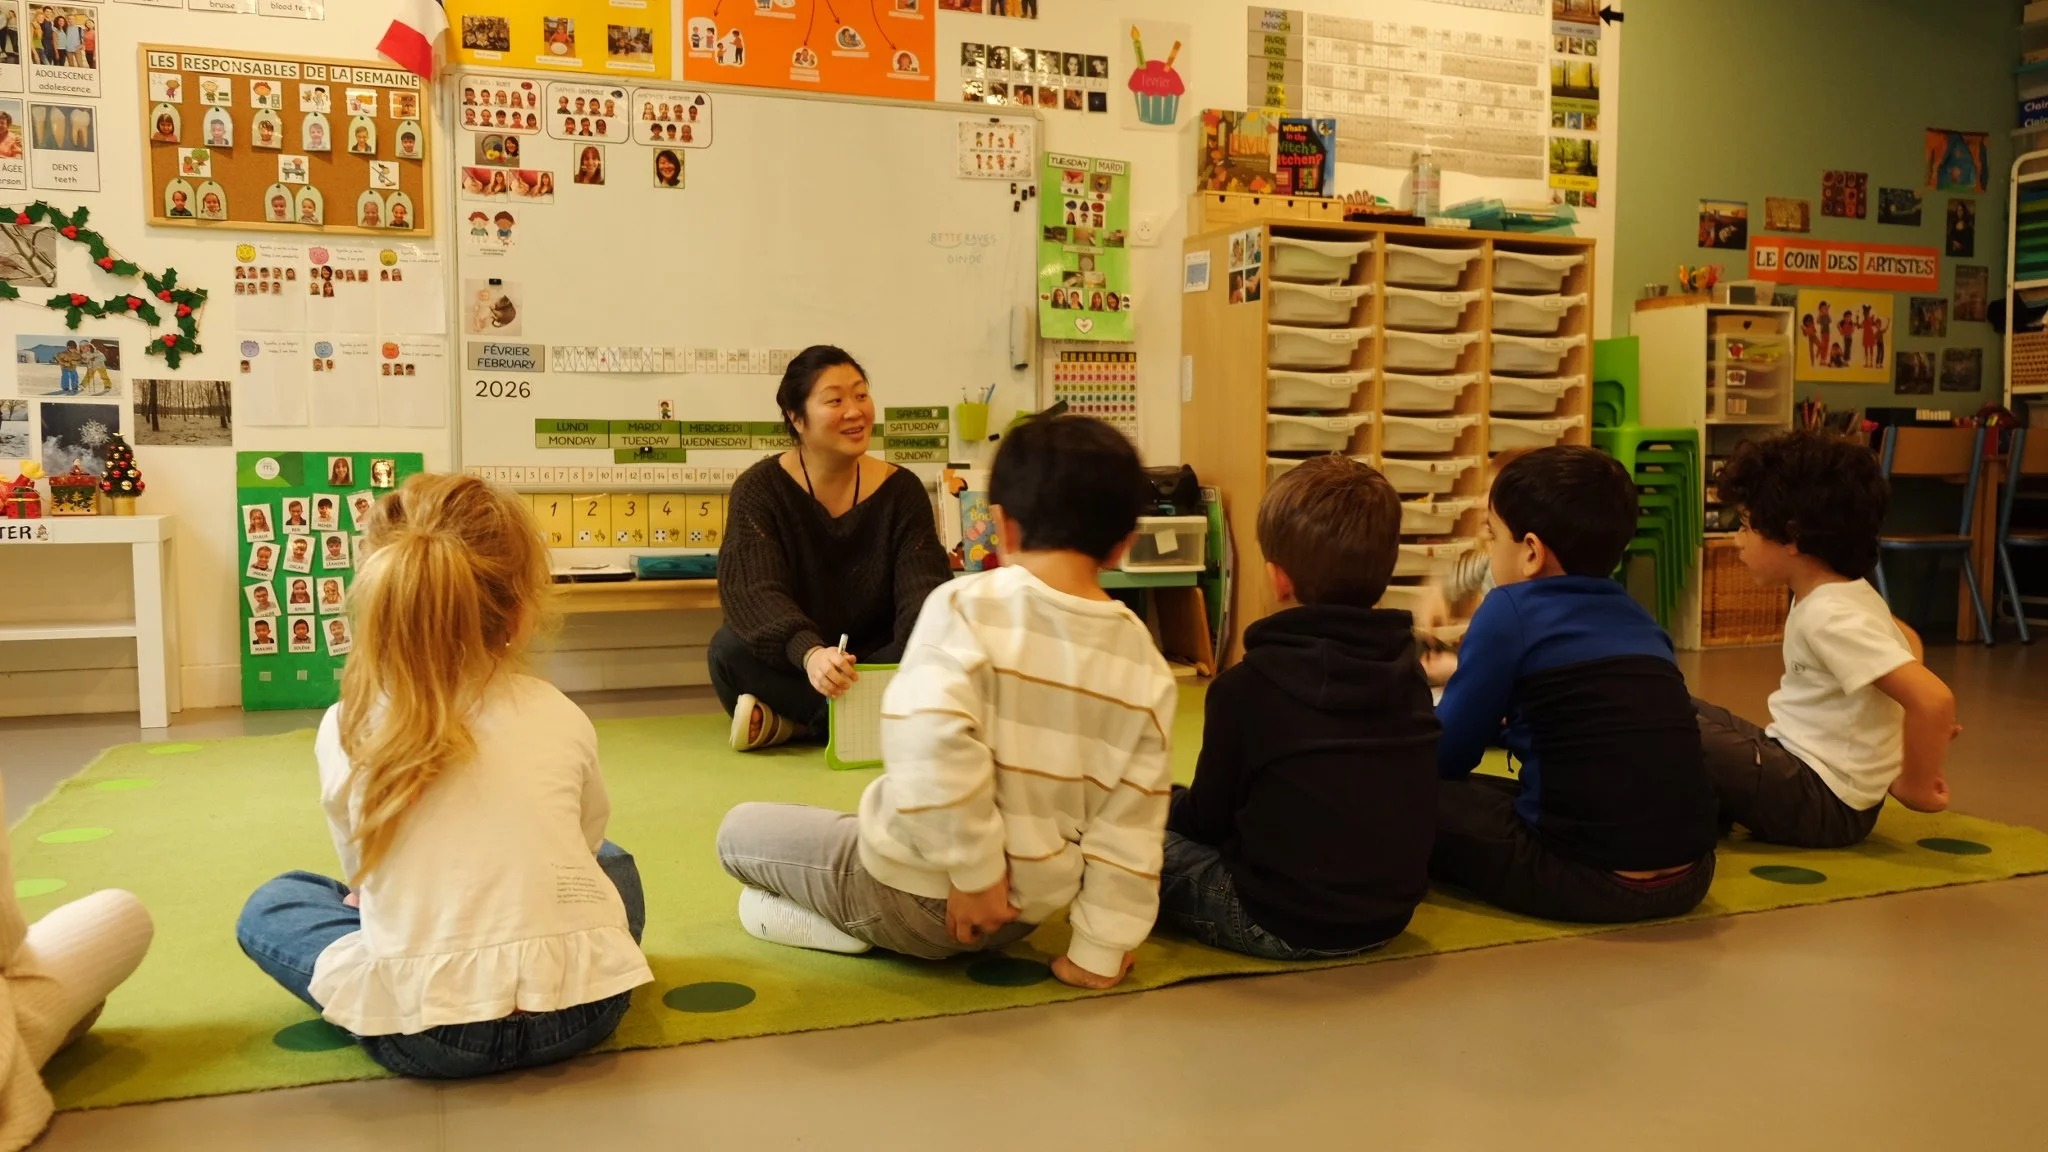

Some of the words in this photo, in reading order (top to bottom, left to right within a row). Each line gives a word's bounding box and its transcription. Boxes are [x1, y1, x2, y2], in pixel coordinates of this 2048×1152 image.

[209, 1, 235, 9] bruise
[270, 3, 292, 11] blood
[294, 4, 311, 12] tet
[1261, 21, 1291, 32] MARCH
[1264, 46, 1287, 57] APRIL
[35, 69, 94, 81] ADOLESCENCE
[150, 55, 175, 68] LES
[183, 57, 297, 77] RESPONSABLES
[306, 66, 325, 78] DE
[332, 68, 348, 81] LA
[355, 70, 419, 87] SEMAINE
[39, 83, 91, 94] adolescence
[1282, 124, 1307, 132] What's
[52, 163, 78, 172] DENTS
[1051, 157, 1087, 168] TUESDAY
[1098, 161, 1123, 172] MARDI
[54, 175, 77, 184] teeth
[1756, 251, 1776, 267] LE
[1784, 251, 1820, 269] COIN
[1828, 254, 1858, 271] DES
[1866, 256, 1933, 276] ARTISTES
[484, 344, 530, 356] FÉVRIER
[477, 357, 536, 369] FEBRUARY
[475, 380, 531, 398] 2026
[556, 422, 588, 432] LUNDI
[628, 422, 662, 432] MARDI
[689, 423, 743, 433] MERCREDI
[890, 422, 940, 432] SATURDAY
[548, 436, 597, 446] MONDAY
[621, 436, 669, 446] TUESDAY
[682, 438, 747, 447] WEDNESDAY
[894, 451, 934, 460] SUNDAY
[550, 502, 557, 516] 1
[587, 501, 598, 516] 2
[625, 501, 635, 517] 3
[662, 501, 672, 515] 4
[699, 502, 710, 517] 5
